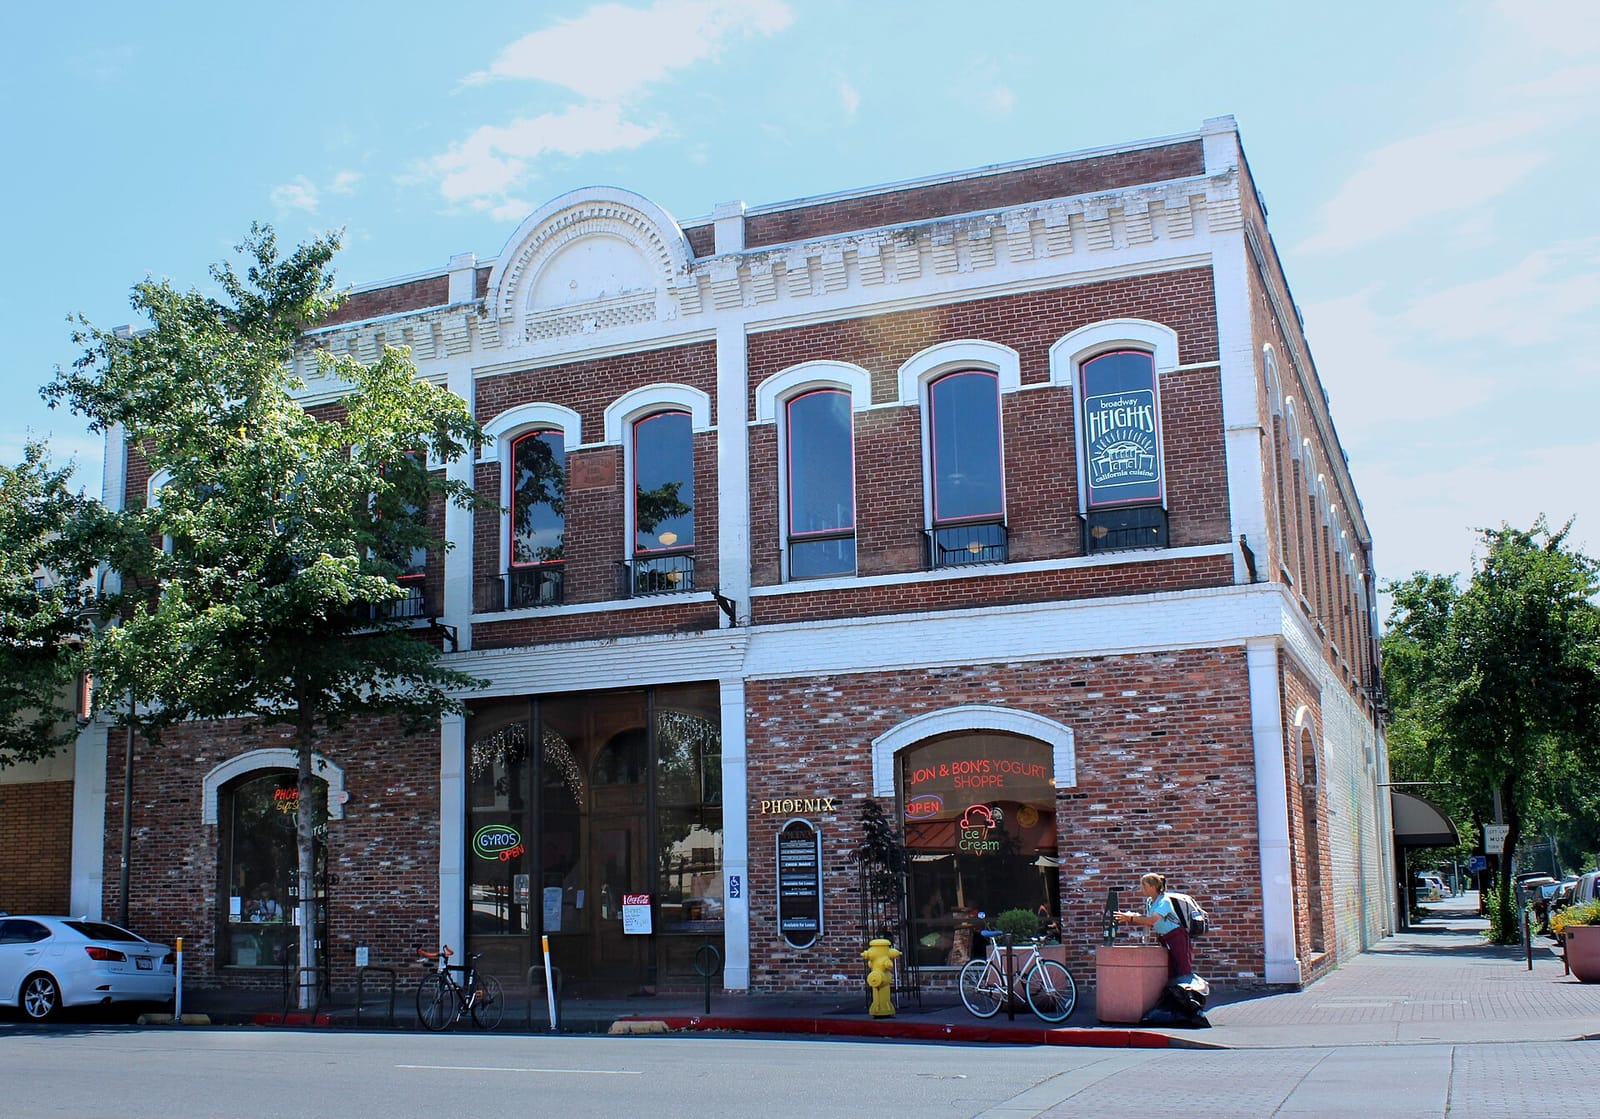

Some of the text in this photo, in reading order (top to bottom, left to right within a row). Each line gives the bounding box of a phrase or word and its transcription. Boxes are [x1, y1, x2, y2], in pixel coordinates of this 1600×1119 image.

[1101, 397, 1138, 408] broadway
[1090, 405, 1153, 443] HEIGHTS
[1096, 468, 1154, 482] california cuisine
[911, 759, 1047, 785] JON & BON'S YOGURT
[954, 774, 1004, 789] SHOPPE
[760, 797, 836, 815] PHOENIX
[906, 801, 939, 815] OPEN
[480, 833, 517, 846] GYROS
[961, 829, 980, 840] Ice
[498, 843, 525, 862] OPEN
[959, 840, 1000, 851] Cream
